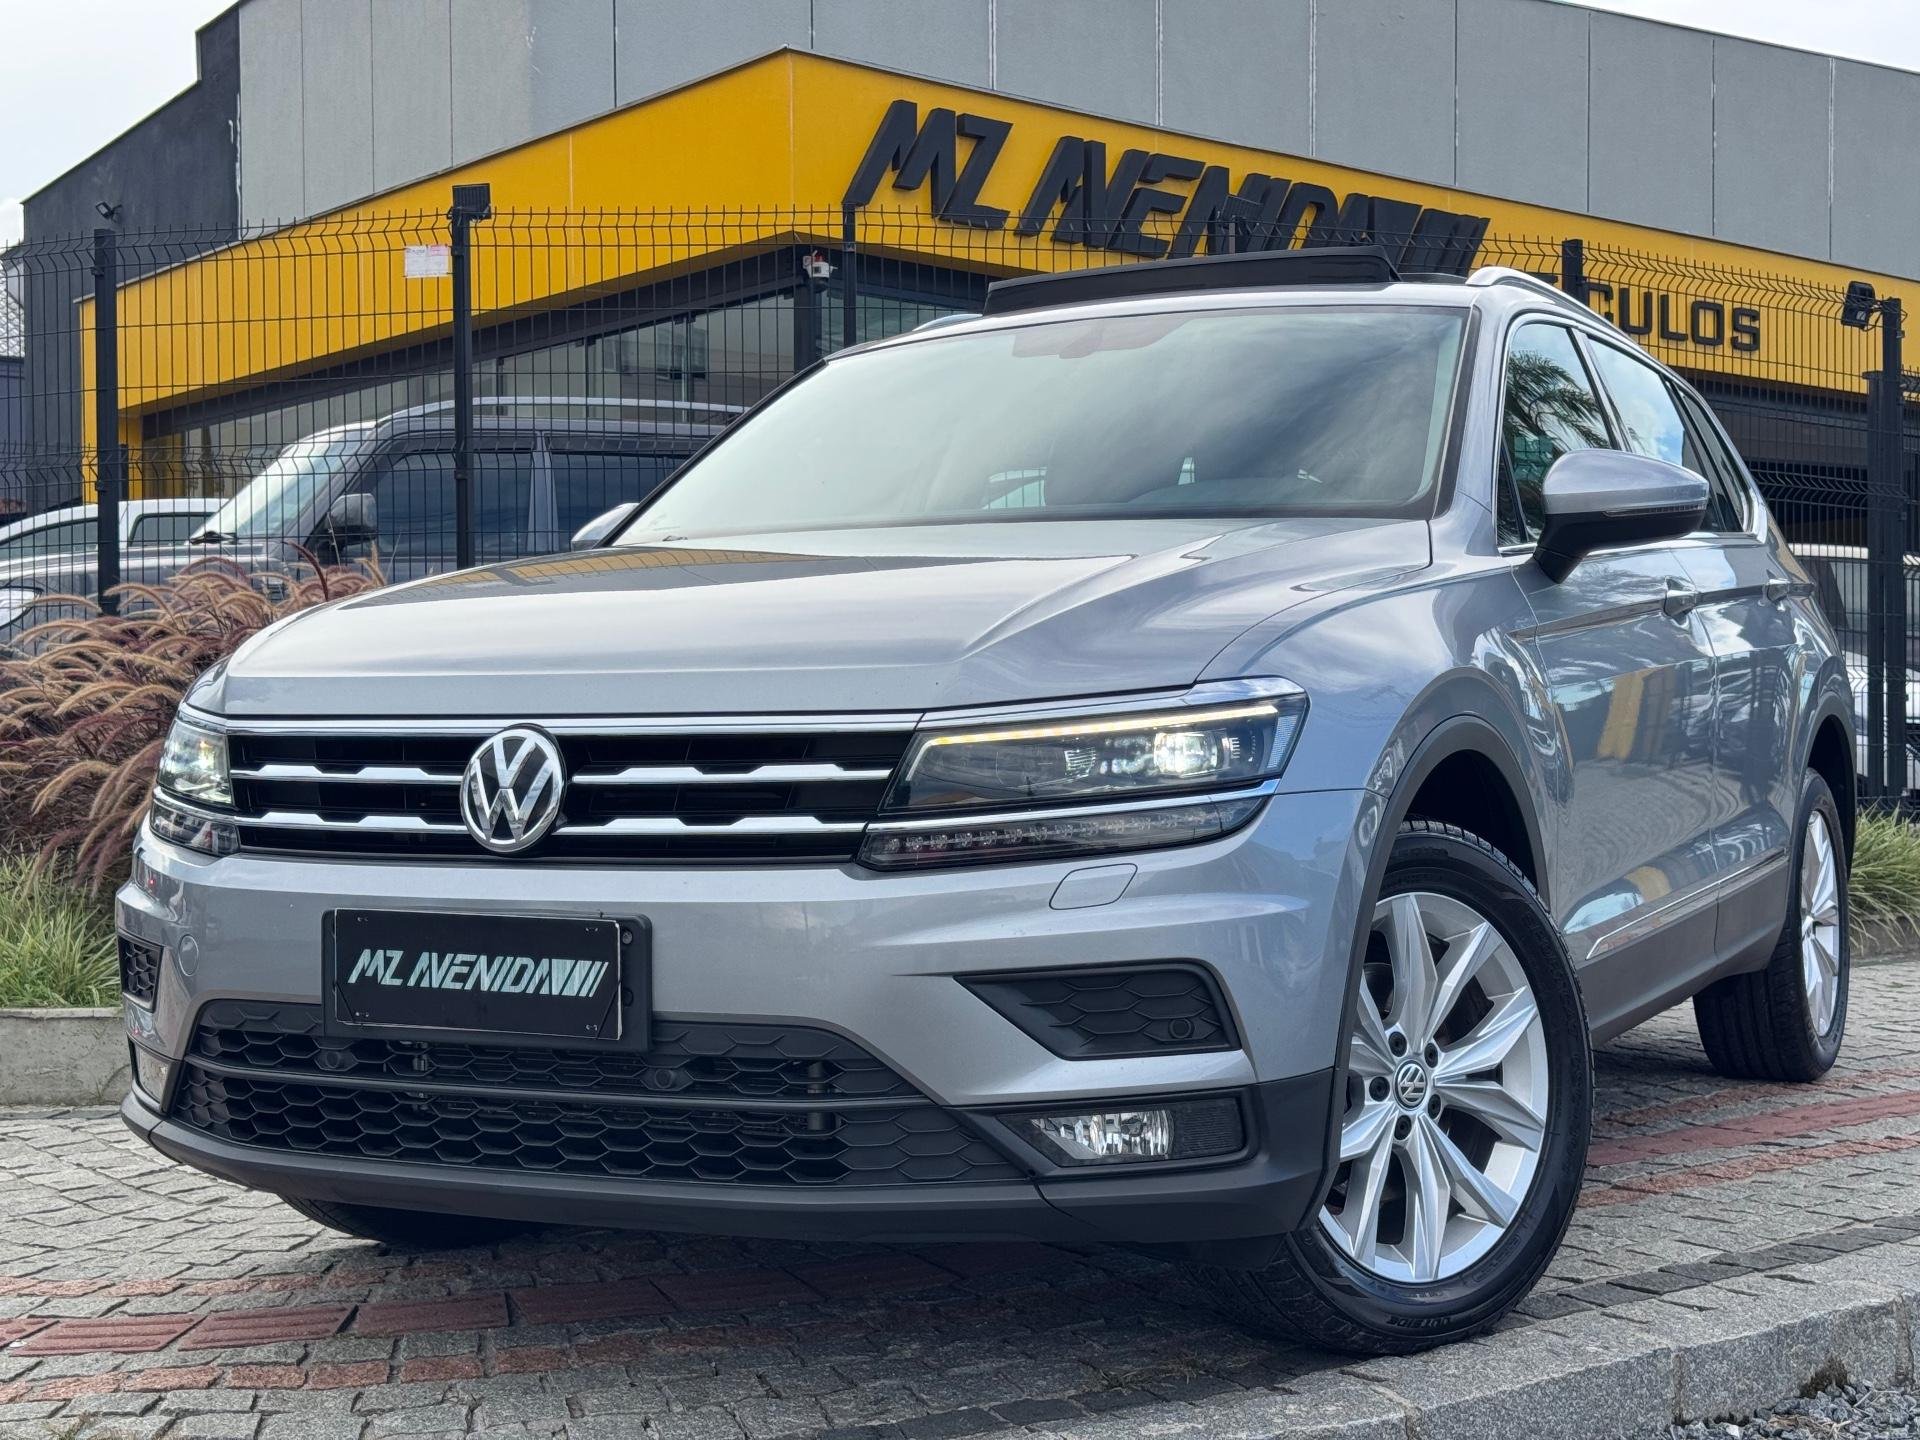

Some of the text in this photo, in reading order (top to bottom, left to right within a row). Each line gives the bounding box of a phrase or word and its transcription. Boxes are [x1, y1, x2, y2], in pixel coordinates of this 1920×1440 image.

[842, 99, 1013, 229] MZ
[348, 948, 582, 996] MZ AVENIDA
